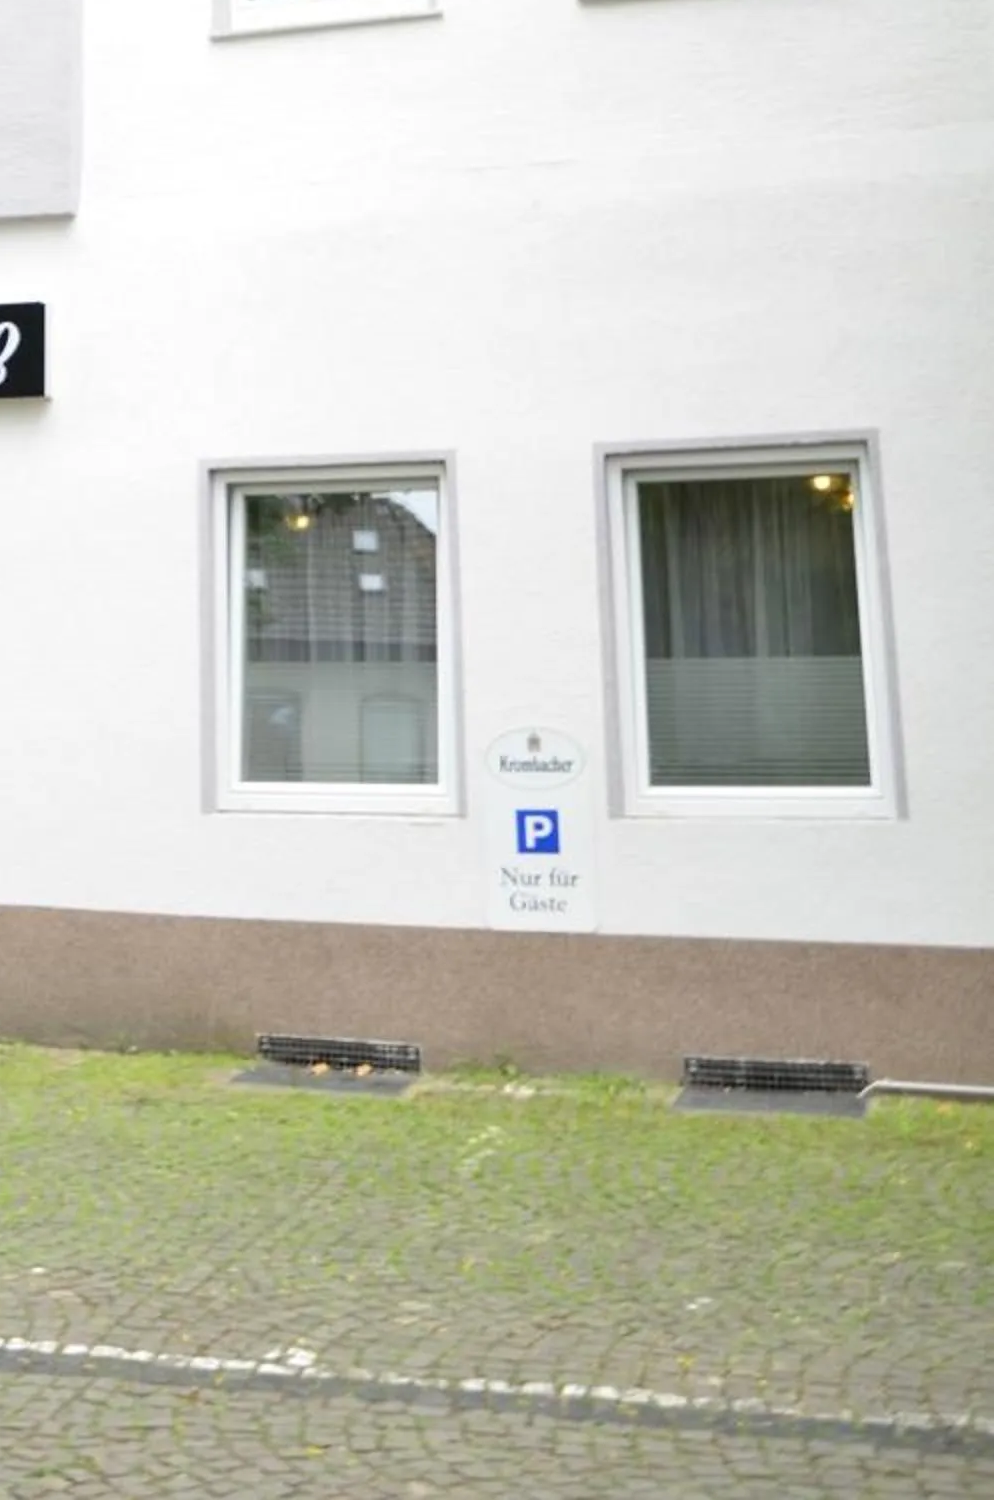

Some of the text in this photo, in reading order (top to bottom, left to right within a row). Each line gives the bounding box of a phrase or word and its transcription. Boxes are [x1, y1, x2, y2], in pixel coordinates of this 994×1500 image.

[524, 816, 553, 850] P
[499, 867, 579, 888] Nur für
[509, 890, 568, 913] Gäste
